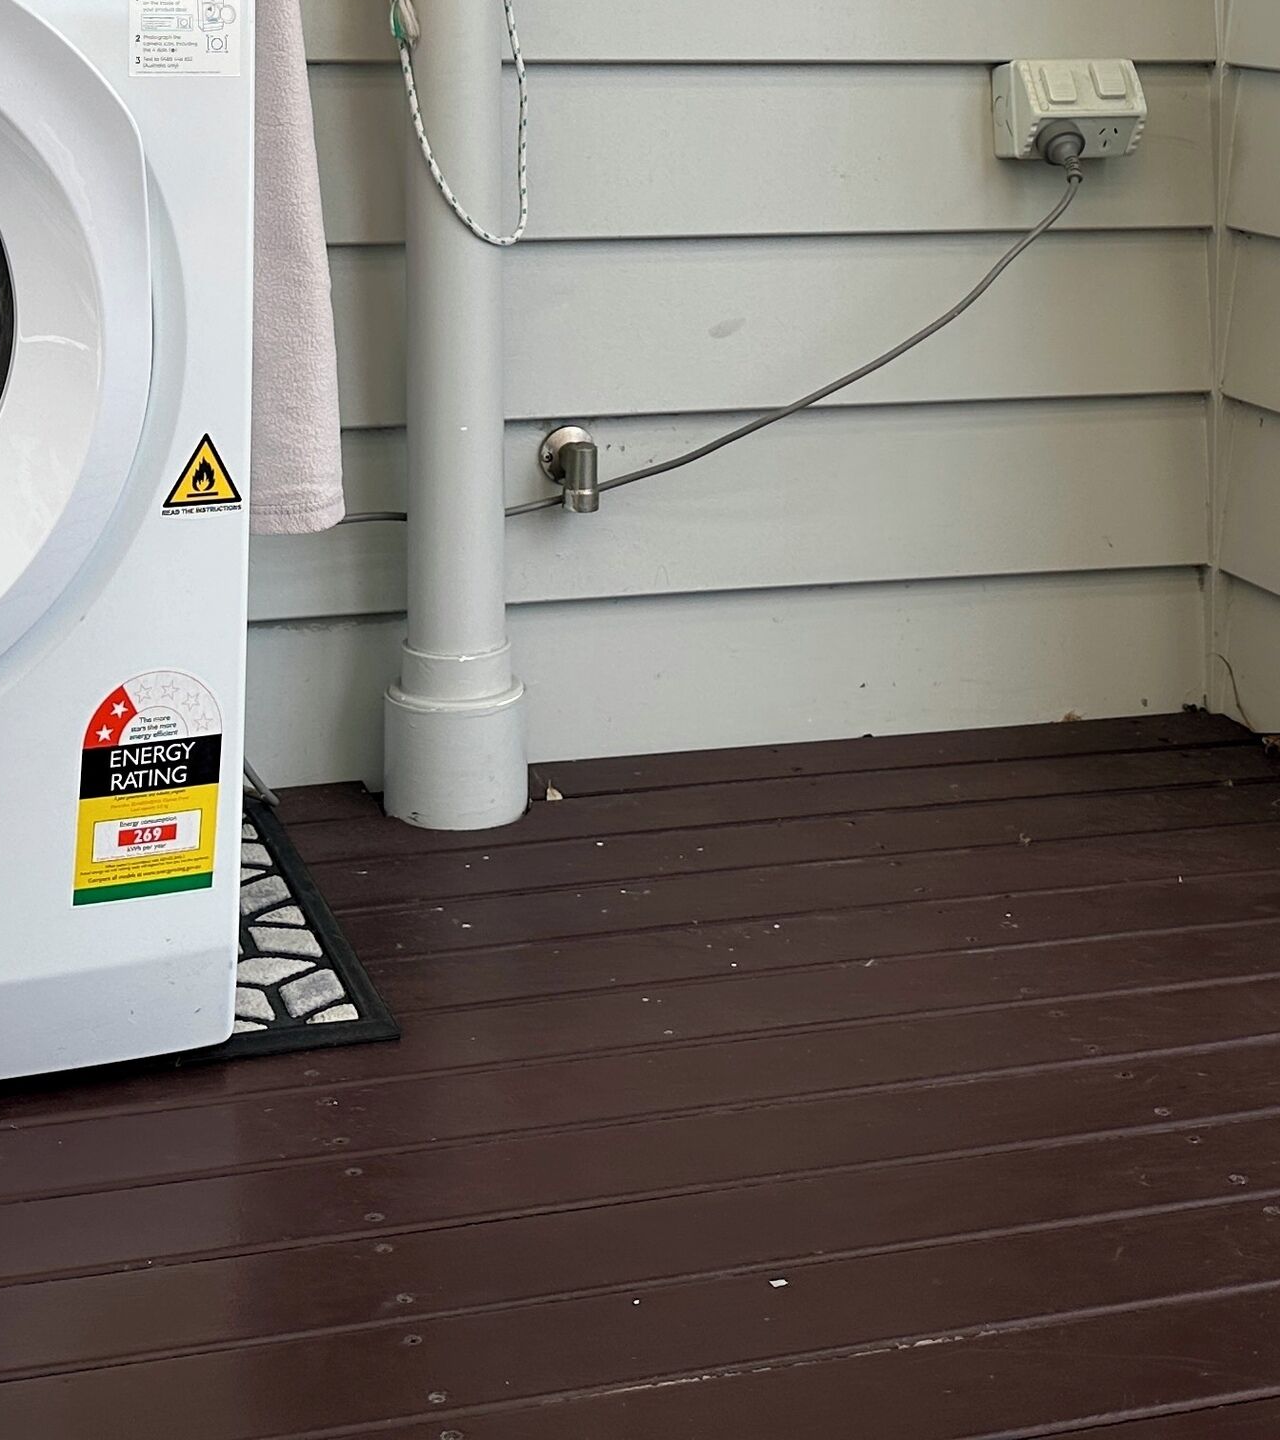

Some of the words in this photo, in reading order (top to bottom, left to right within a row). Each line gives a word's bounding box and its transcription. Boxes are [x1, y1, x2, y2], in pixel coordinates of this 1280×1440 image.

[196, 505, 242, 513] INSTRUCTIONS
[129, 733, 152, 741] energy
[153, 729, 178, 738] efficient
[110, 741, 196, 768] ENERGY
[110, 765, 187, 792] RATING
[133, 827, 162, 844] 269
